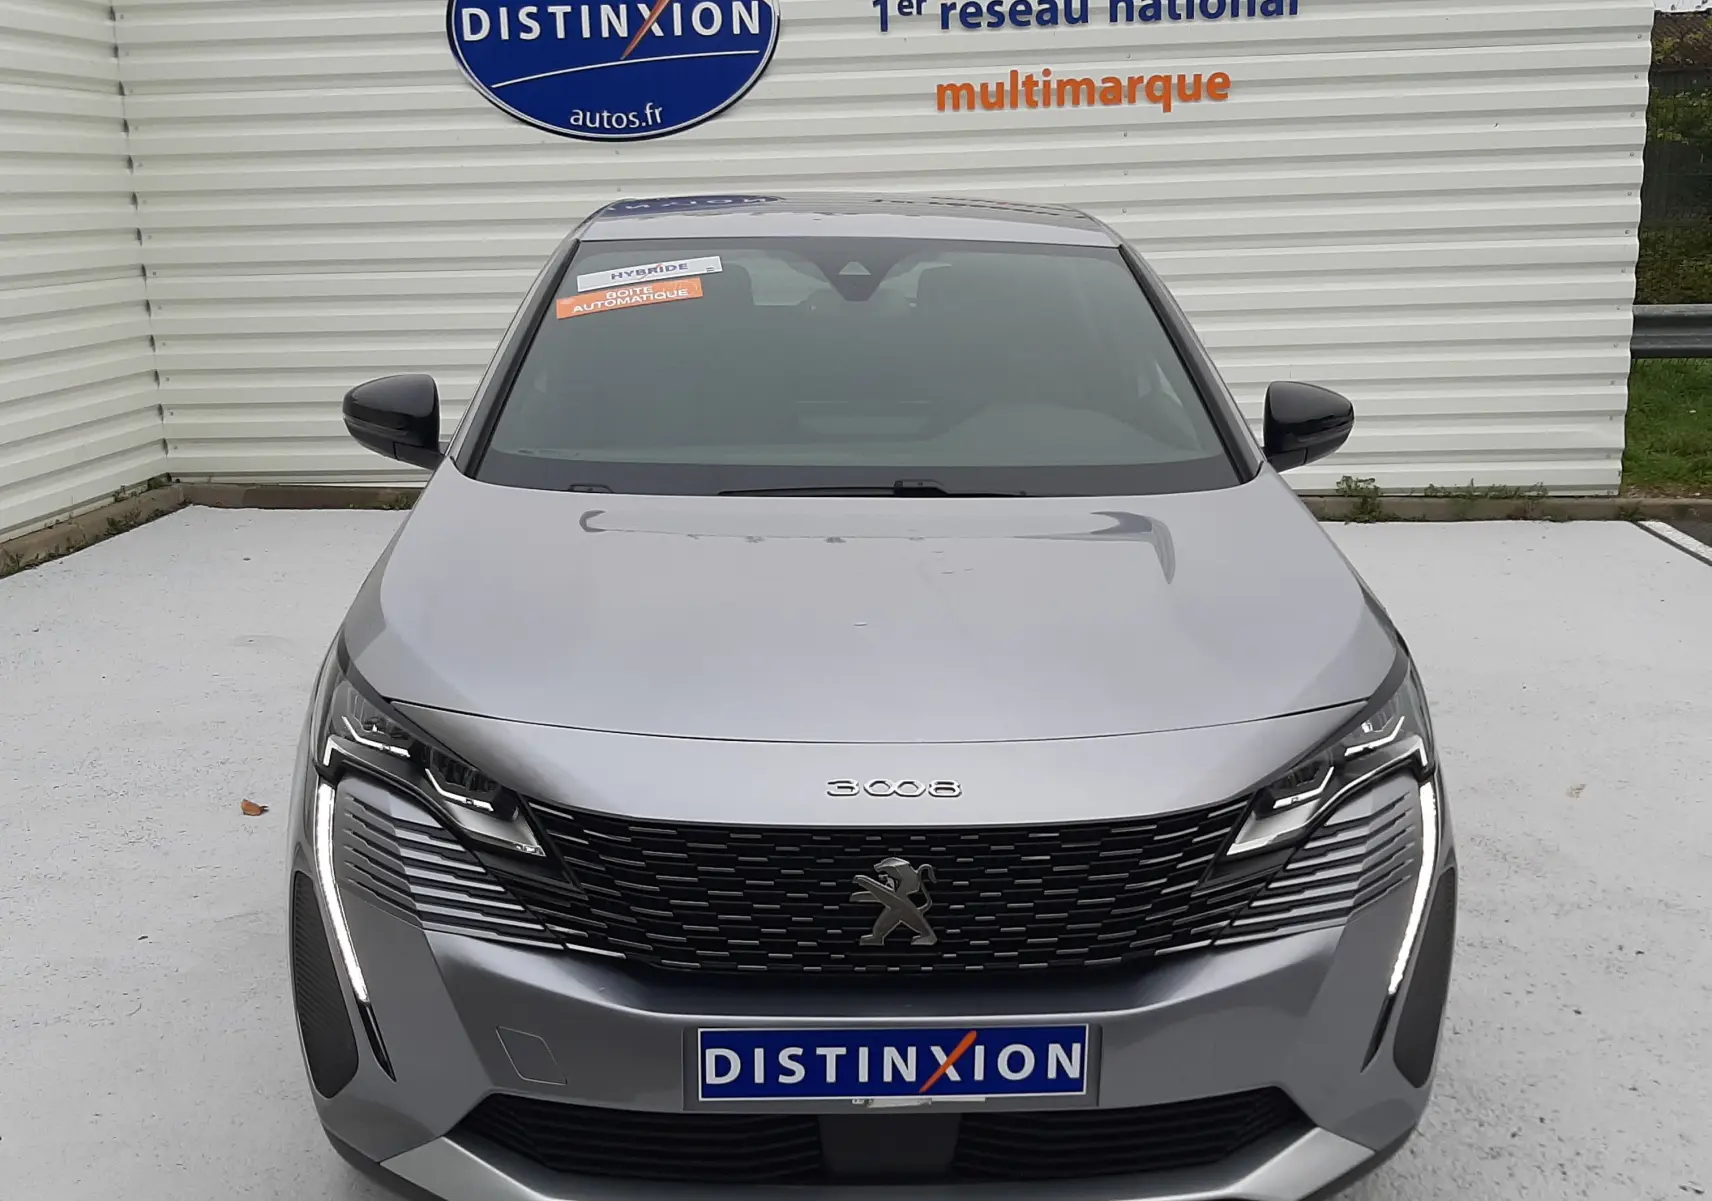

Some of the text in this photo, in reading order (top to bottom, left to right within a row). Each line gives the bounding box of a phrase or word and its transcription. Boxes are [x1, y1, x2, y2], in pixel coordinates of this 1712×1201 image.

[461, 0, 760, 52] DISTINXION
[935, 69, 1231, 113] multimarque
[569, 102, 664, 129] autos.fr
[611, 263, 688, 279] HYBRIDE
[573, 288, 689, 312] AUTOMATIQUE
[606, 286, 653, 299] BOITE
[826, 778, 962, 798] 3008
[705, 1036, 1081, 1090] DISTINXION
